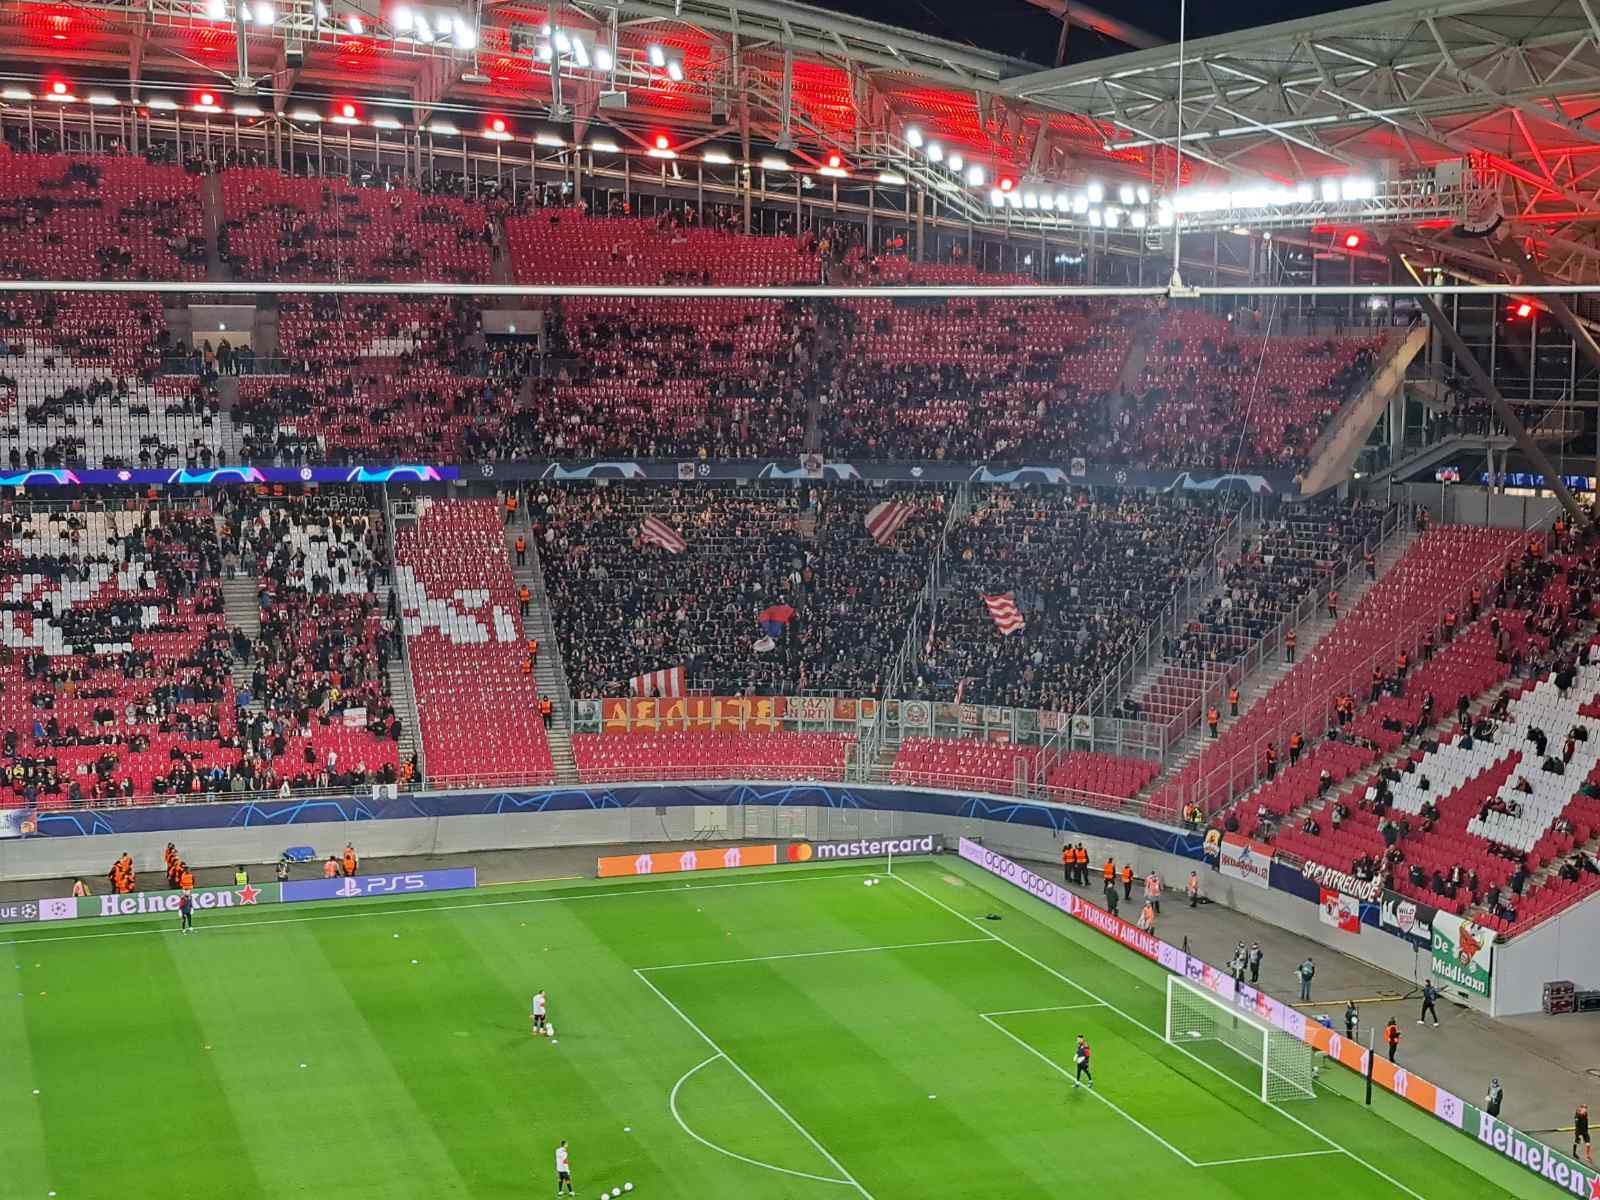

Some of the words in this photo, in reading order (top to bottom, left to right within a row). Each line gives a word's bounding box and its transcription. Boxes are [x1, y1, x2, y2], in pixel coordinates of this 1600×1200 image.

[817, 834, 933, 858] mastercard
[367, 874, 425, 893] PS5
[984, 851, 1015, 876] oppo
[1020, 869, 1054, 897] oppo
[1083, 903, 1120, 937] TURKISH
[1120, 924, 1159, 957] AIRLINES
[1433, 934, 1449, 953] De
[1477, 1111, 1586, 1197] Heineken
